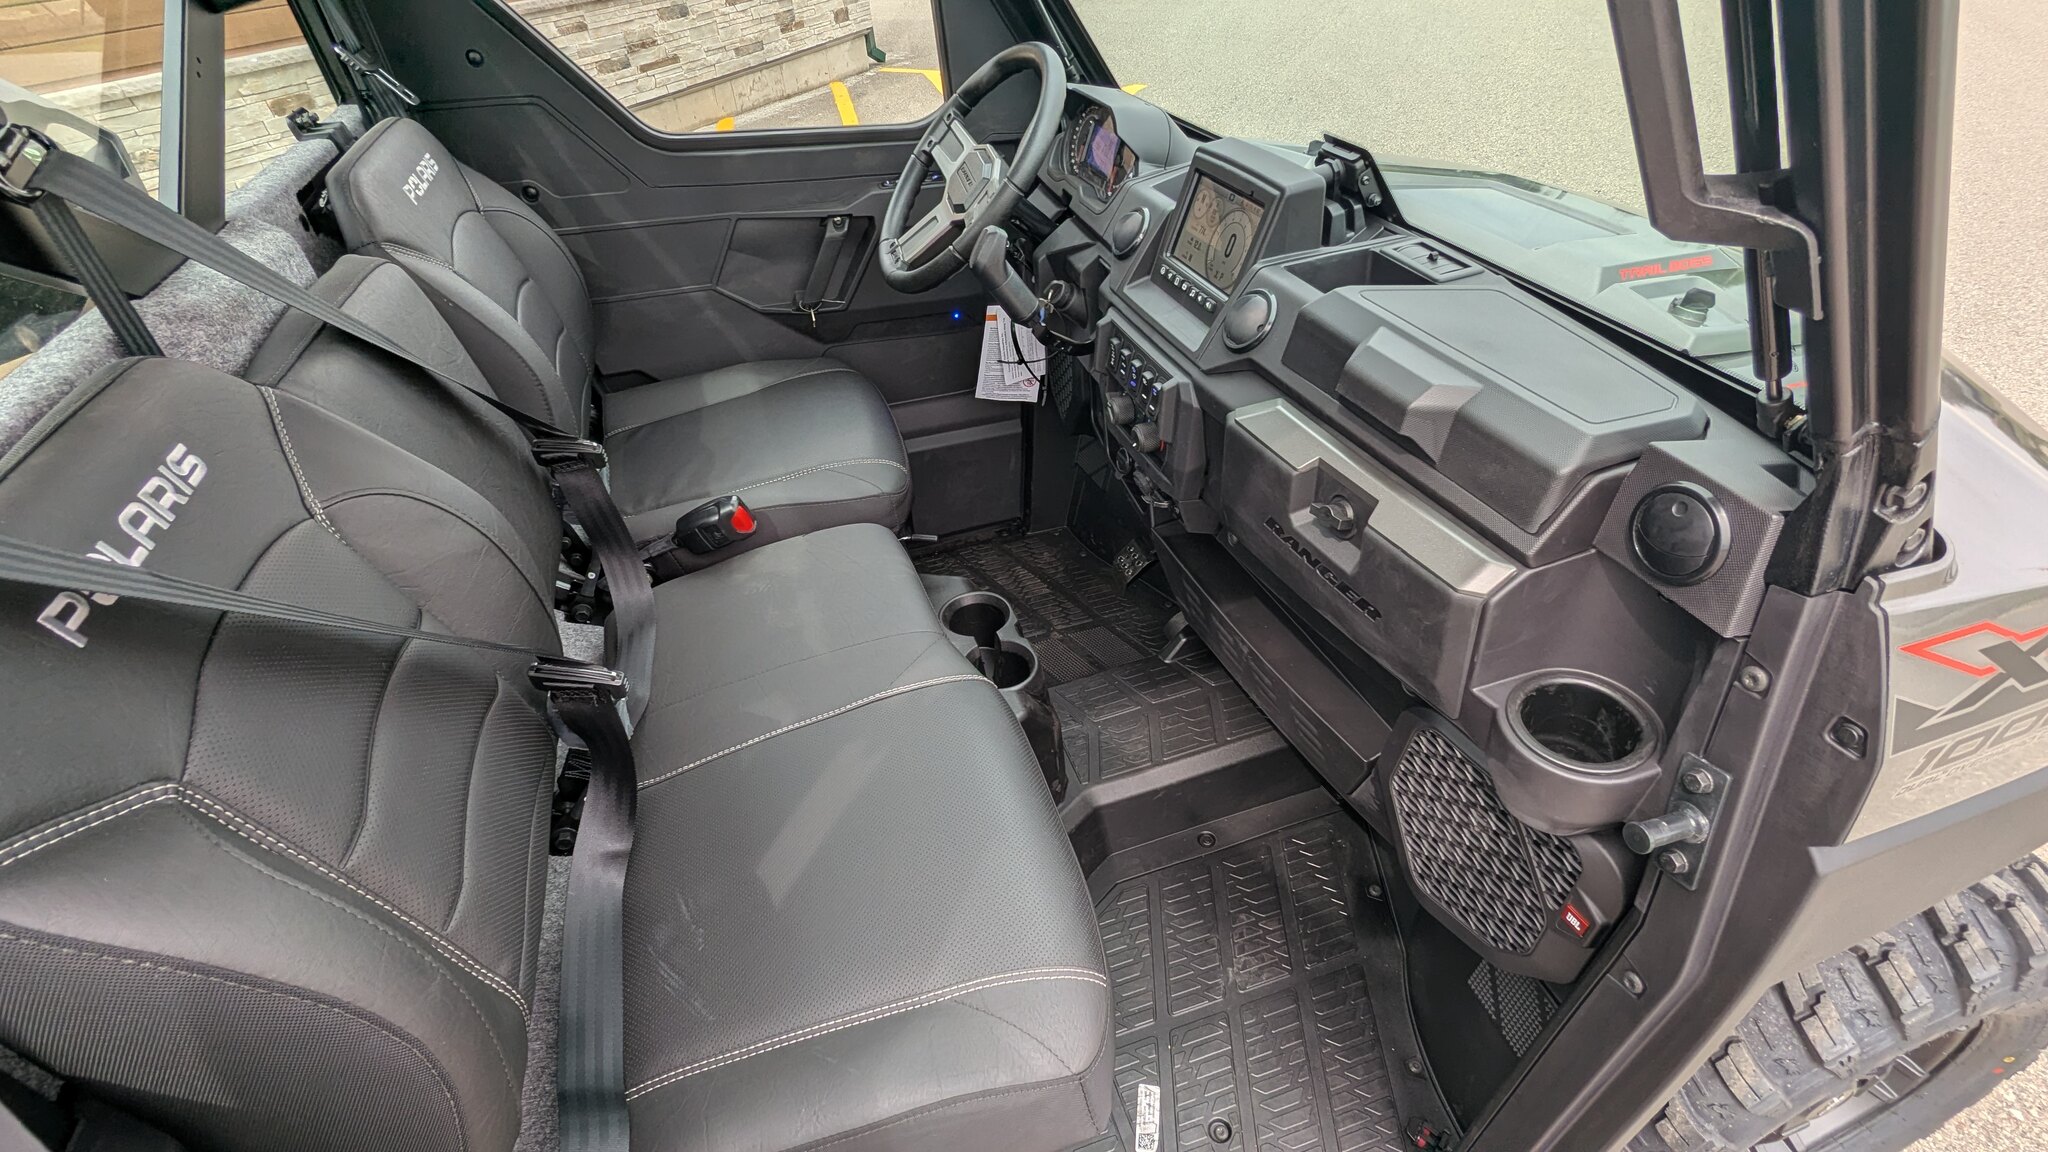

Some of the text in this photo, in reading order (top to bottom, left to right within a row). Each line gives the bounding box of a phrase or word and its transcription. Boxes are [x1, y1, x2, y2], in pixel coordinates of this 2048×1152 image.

[402, 152, 439, 206] POLARIS
[1619, 255, 1713, 281] TRAIL BOSS
[36, 442, 208, 649] PLARIS
[1263, 516, 1382, 623] RANGER
[1565, 911, 1581, 931] JBL
